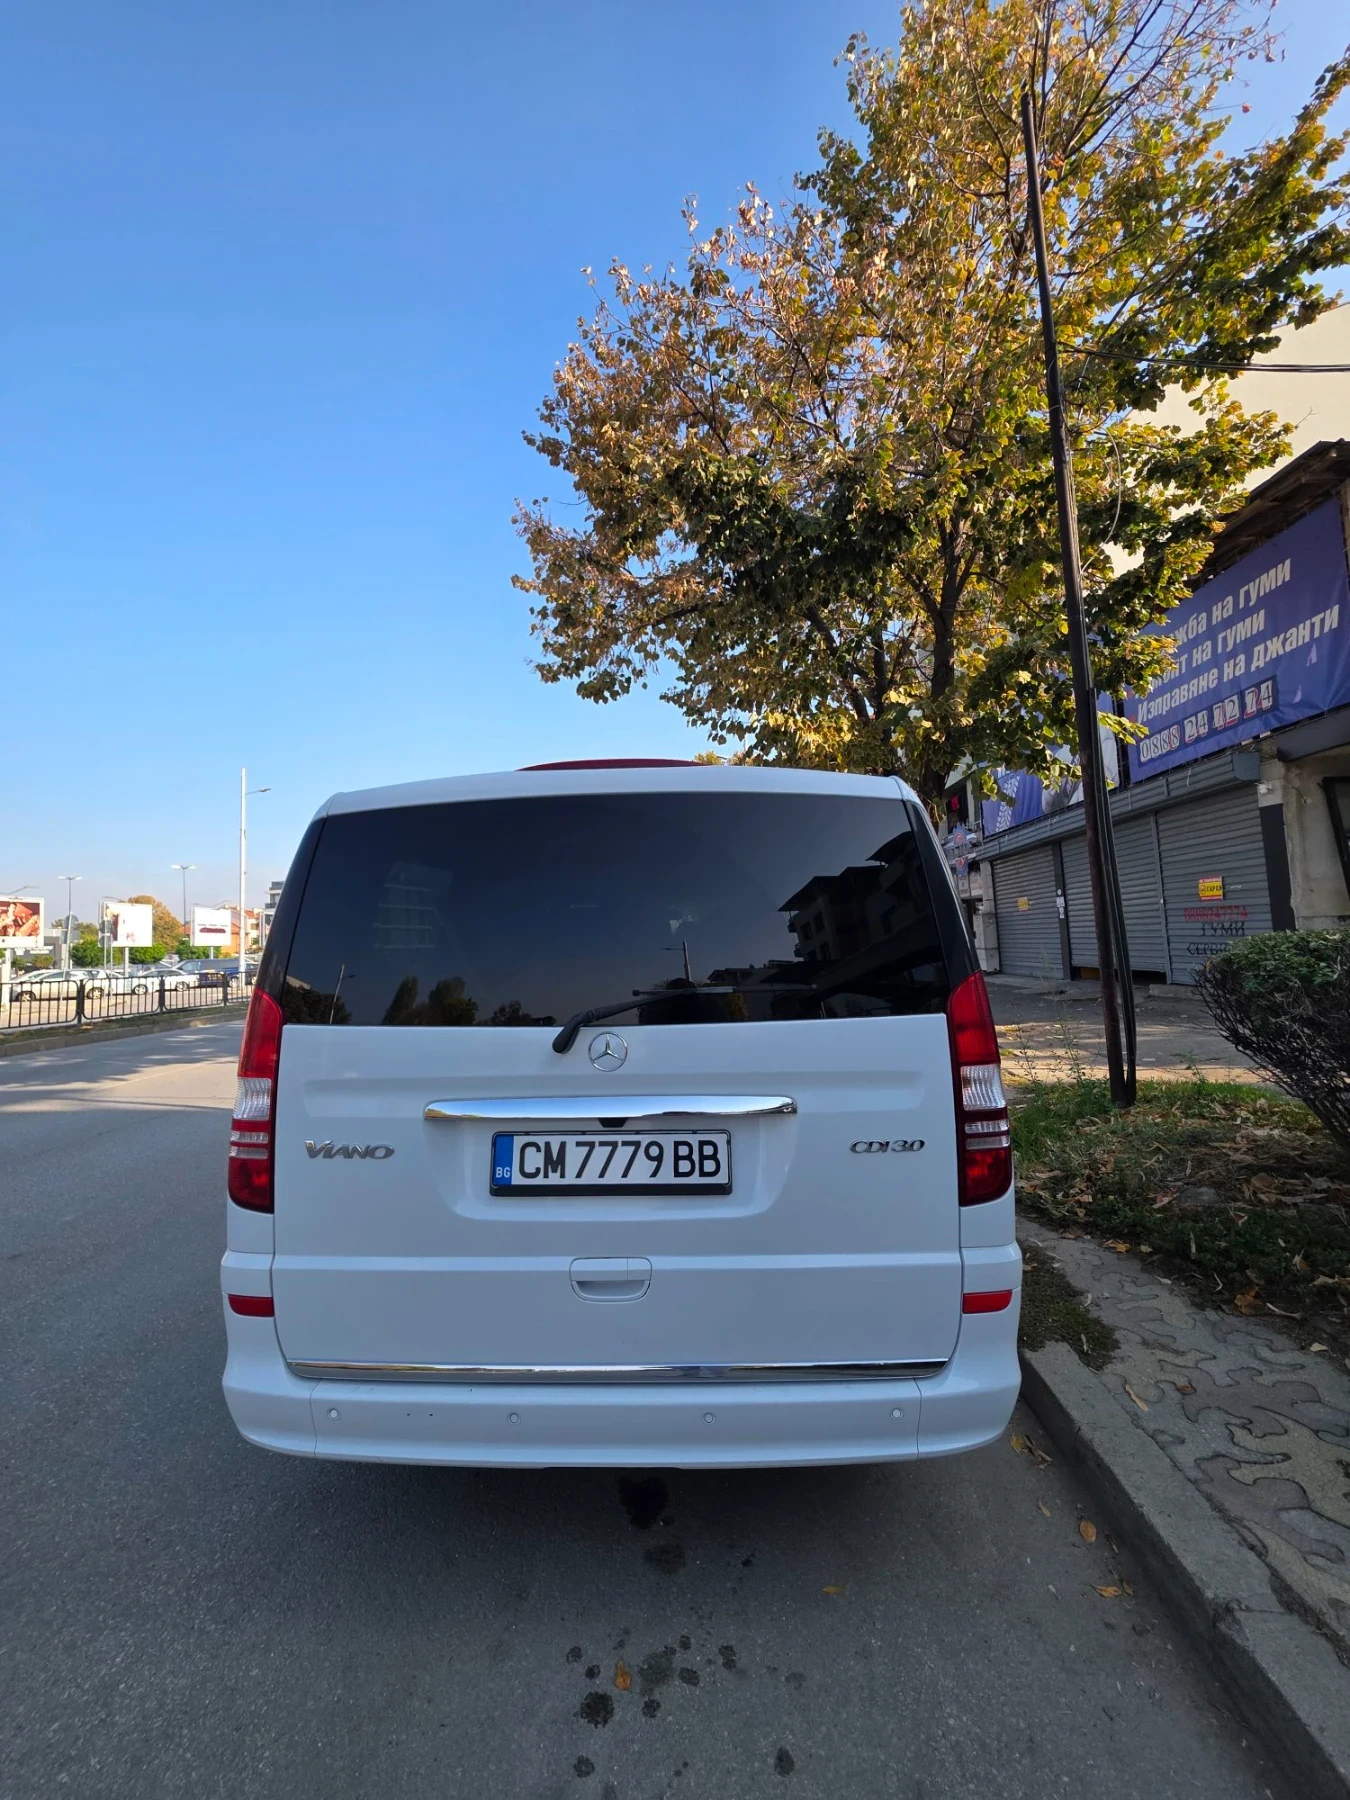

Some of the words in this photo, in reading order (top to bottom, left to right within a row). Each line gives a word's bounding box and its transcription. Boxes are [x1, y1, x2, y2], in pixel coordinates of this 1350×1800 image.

[1212, 595, 1234, 626] на
[1239, 558, 1291, 609] гуми
[1192, 640, 1212, 667] на
[1217, 609, 1265, 654] гуми
[1137, 667, 1219, 724] Изправяне
[1223, 653, 1246, 683] на
[1251, 604, 1340, 673] джанти
[1139, 724, 1180, 763] 0888
[1201, 921, 1246, 936] ГУМИ
[304, 1140, 395, 1159] VIANO
[850, 1140, 890, 1154] CDI
[495, 1167, 511, 1178] BG
